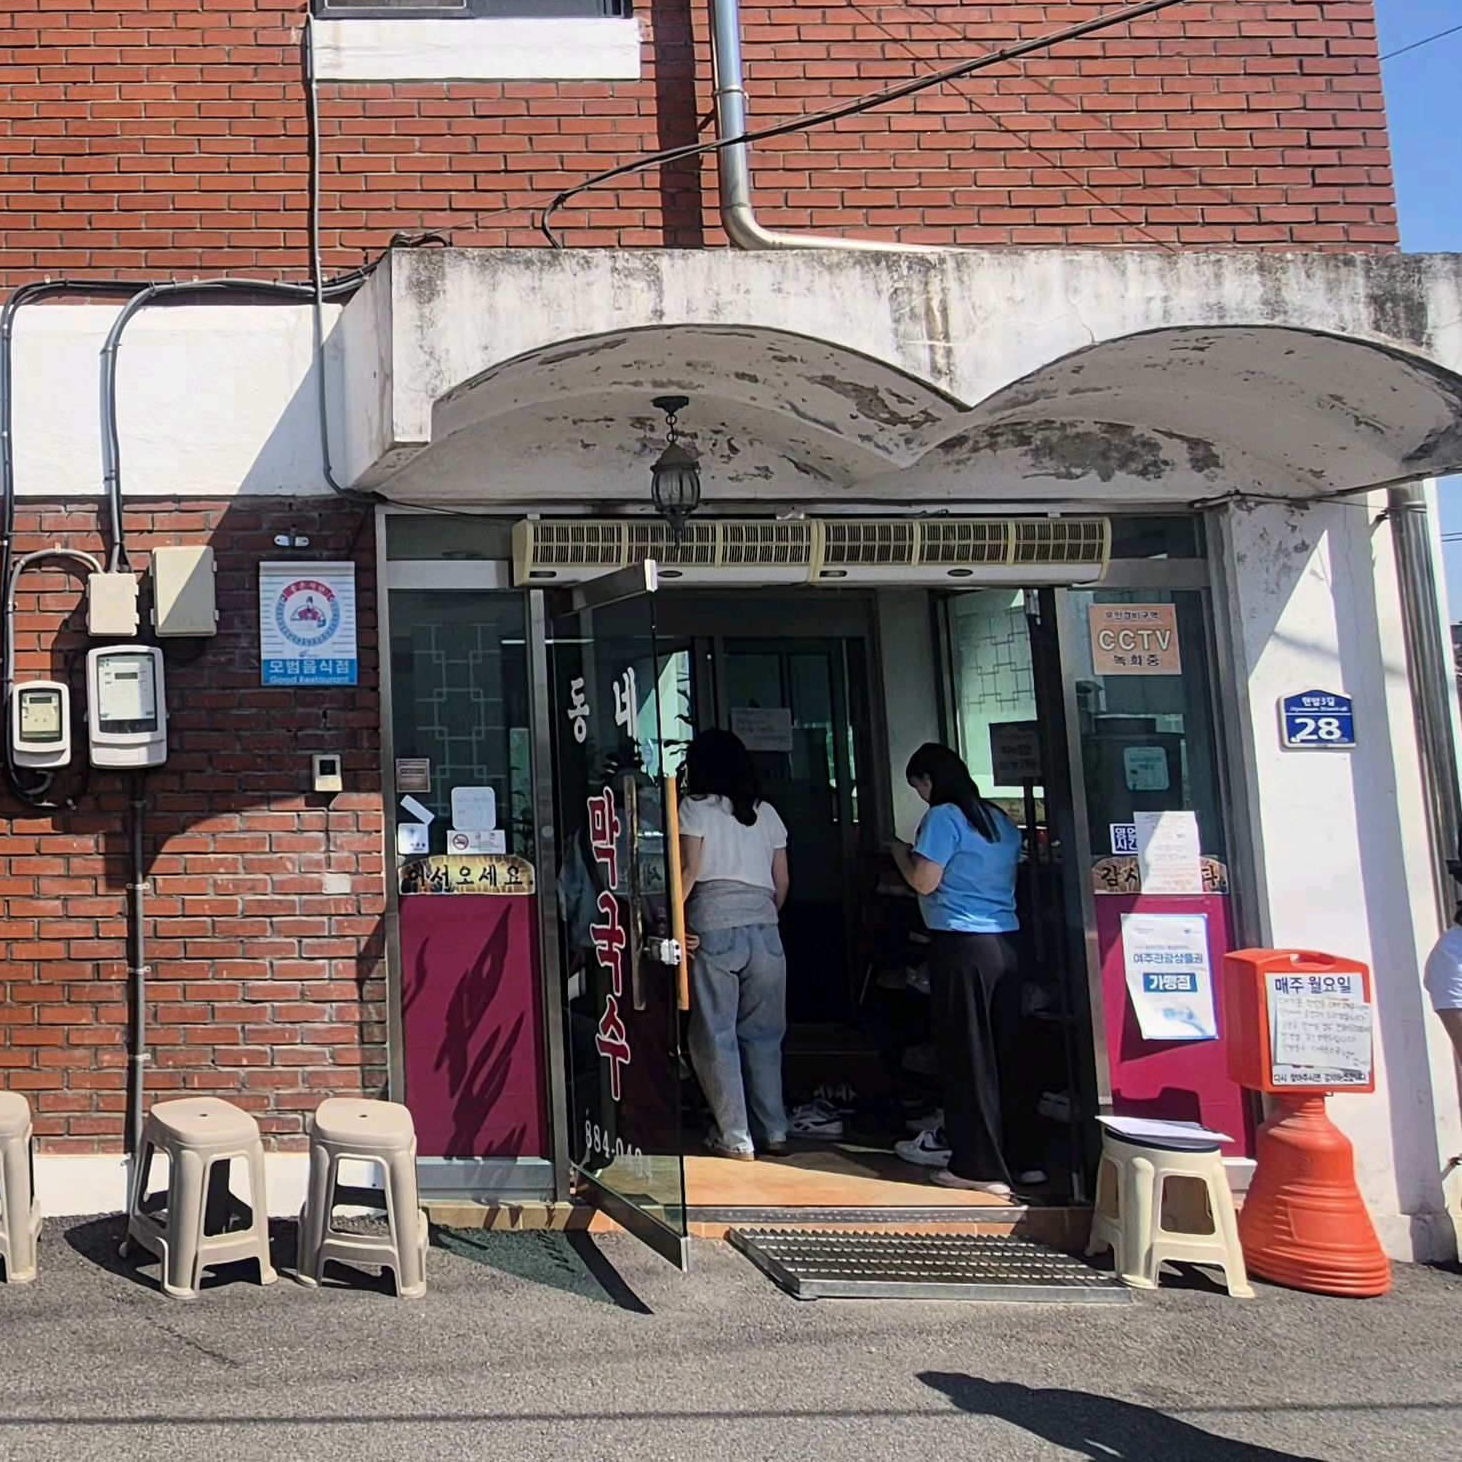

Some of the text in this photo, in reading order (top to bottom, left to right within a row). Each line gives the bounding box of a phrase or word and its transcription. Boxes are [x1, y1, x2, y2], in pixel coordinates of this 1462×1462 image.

[1098, 629, 1171, 651] CCTV
[269, 659, 349, 675] 모범음식점
[1113, 654, 1160, 667] 녹화중
[567, 666, 638, 743] 동네
[1295, 718, 1342, 740] 28
[588, 786, 631, 1101] 막국수
[1149, 975, 1191, 990] 가맹점
[1275, 976, 1352, 994] 매주 월요일
